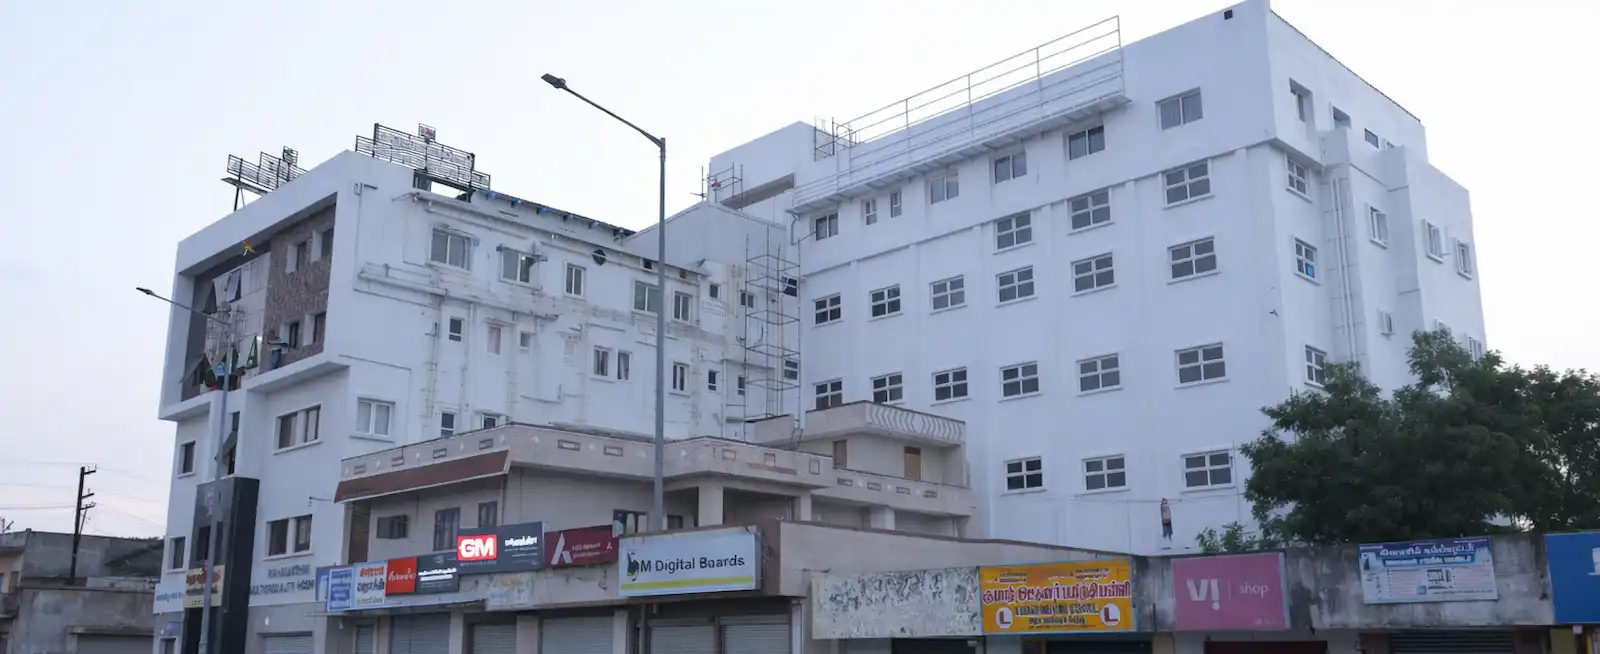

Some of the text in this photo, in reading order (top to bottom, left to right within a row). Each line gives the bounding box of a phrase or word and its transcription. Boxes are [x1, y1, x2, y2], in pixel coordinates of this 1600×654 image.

[459, 537, 495, 558] GM
[655, 557, 696, 575] Digital
[699, 555, 746, 570] Boards
[1239, 582, 1269, 599] shop
[999, 611, 1012, 625] L
[1103, 606, 1119, 623] L
